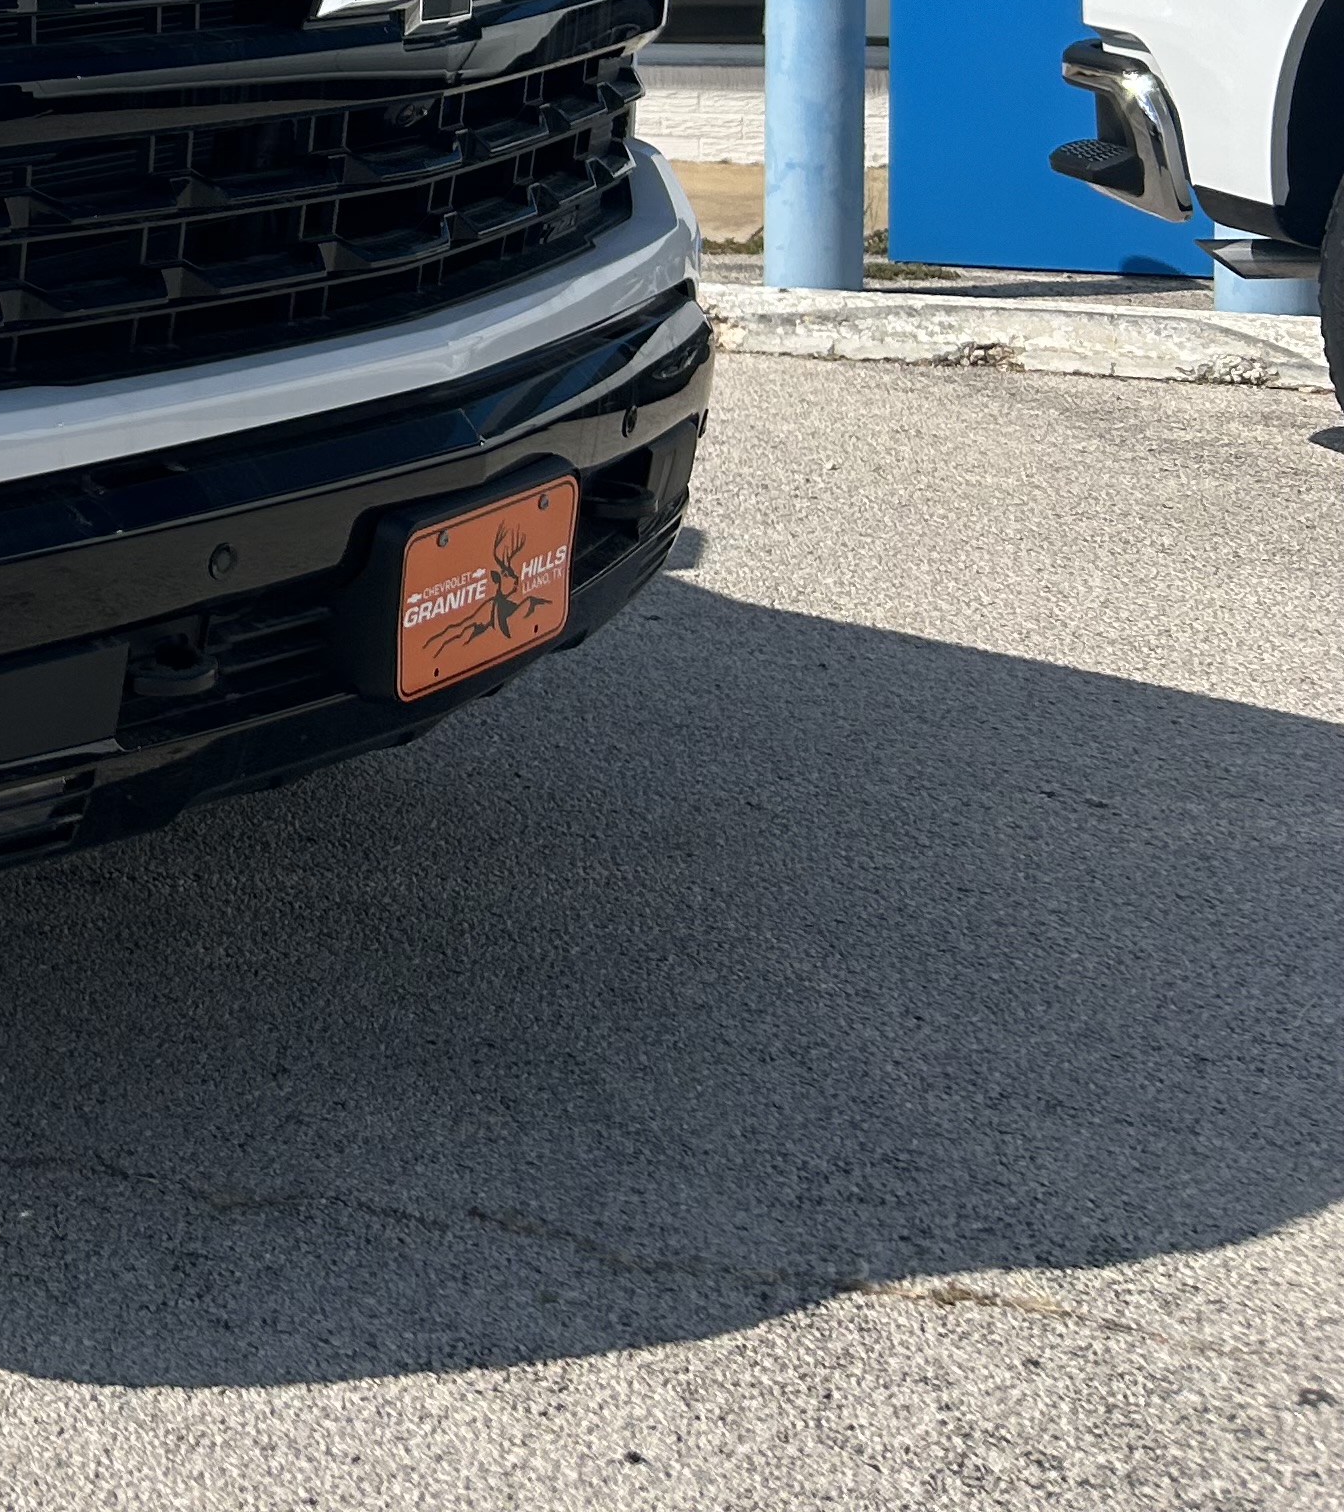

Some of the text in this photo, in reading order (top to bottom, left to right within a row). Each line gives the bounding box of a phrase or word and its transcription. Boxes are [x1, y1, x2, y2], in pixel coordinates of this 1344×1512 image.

[402, 545, 568, 628] GRANITE HILLS
[423, 571, 472, 600] CHEVROLET
